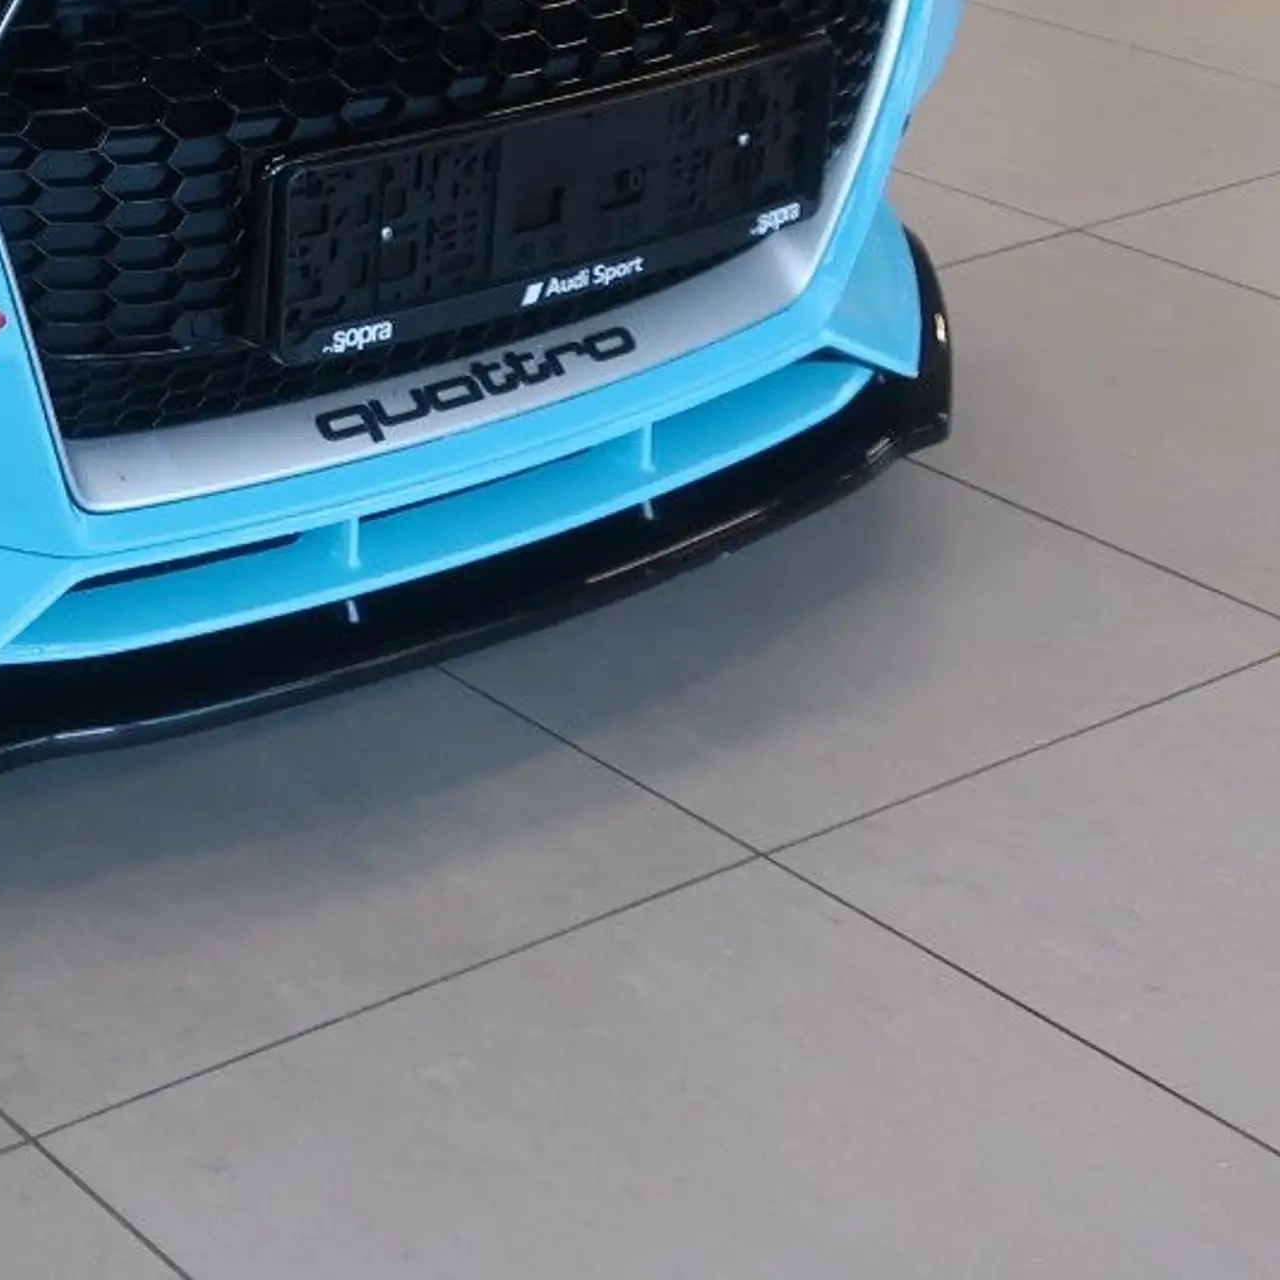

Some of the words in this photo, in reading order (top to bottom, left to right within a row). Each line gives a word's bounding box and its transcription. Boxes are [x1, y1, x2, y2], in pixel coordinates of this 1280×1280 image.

[544, 268, 590, 297] Audi
[592, 255, 645, 286] Sport
[332, 320, 394, 353] sopra
[315, 325, 637, 443] quattro
